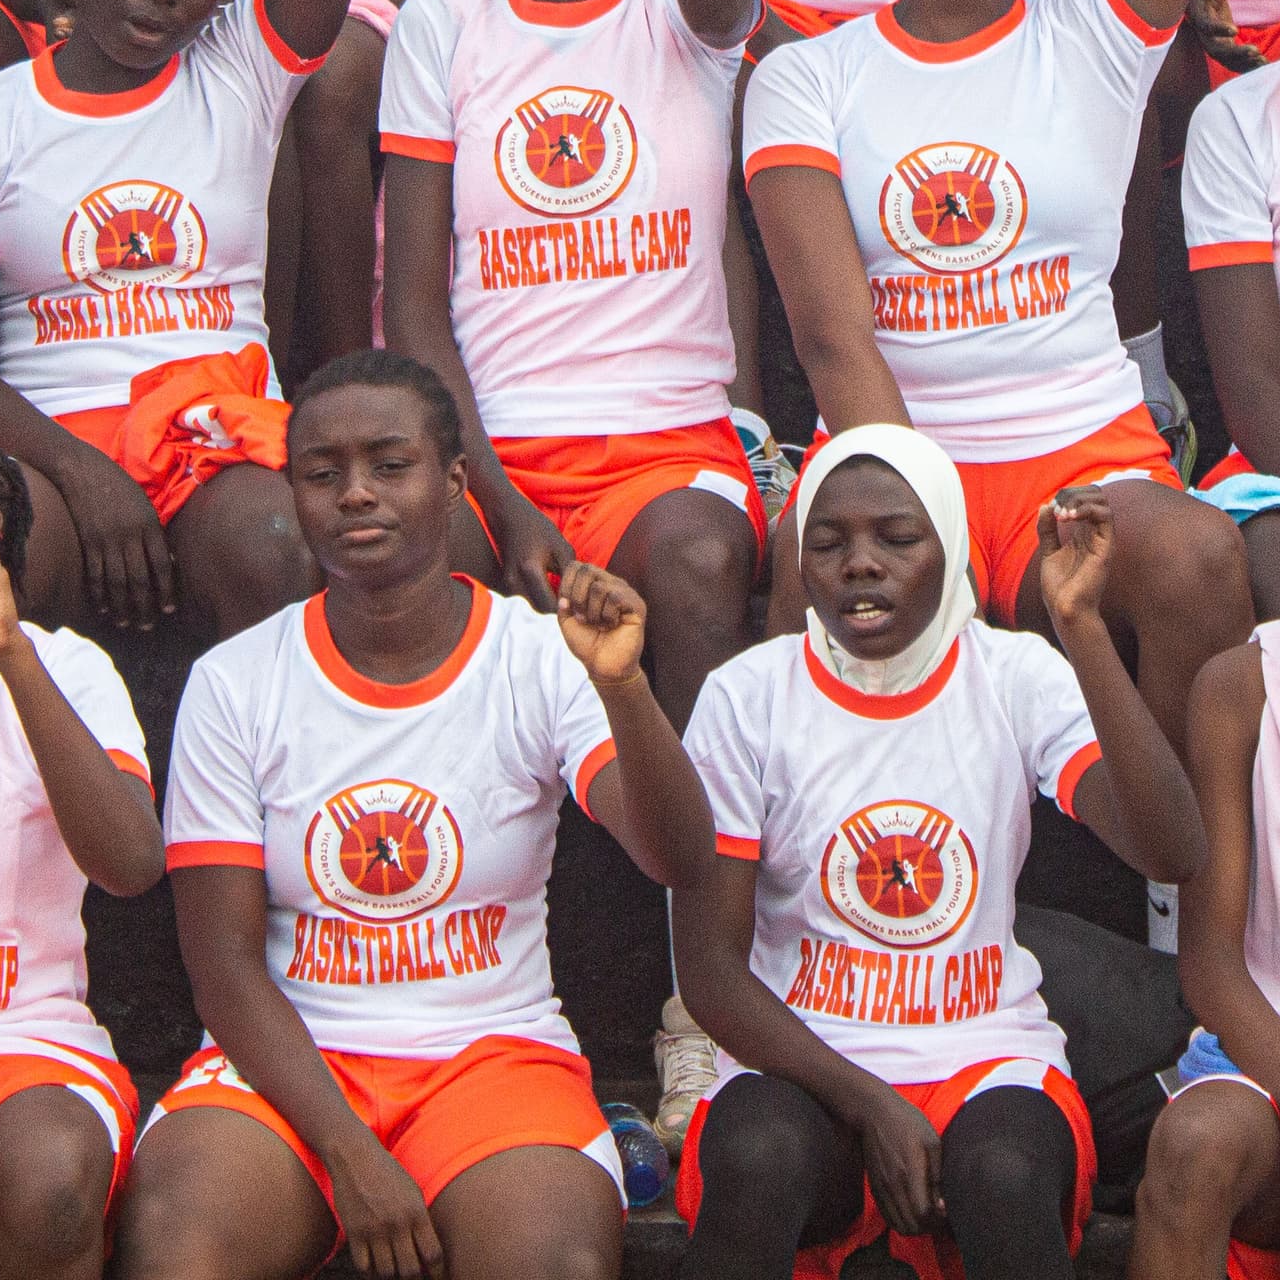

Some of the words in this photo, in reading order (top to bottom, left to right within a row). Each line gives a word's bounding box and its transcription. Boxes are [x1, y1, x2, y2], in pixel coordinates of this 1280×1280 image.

[478, 217, 627, 290] BASKETBALL
[630, 207, 693, 274] CAMP
[871, 268, 1009, 333] ASKETBALL
[1009, 255, 1071, 321] CAMP
[836, 854, 852, 909] VICTORIA'S
[849, 907, 886, 936] QUEENS
[887, 914, 948, 938] BASKETBALL
[945, 847, 964, 915] FOUNDATION
[286, 913, 446, 986] BASKETBALL
[444, 904, 509, 977] CAMP
[785, 937, 937, 1026] BASKETBALL
[942, 943, 1004, 1023] CAMP
